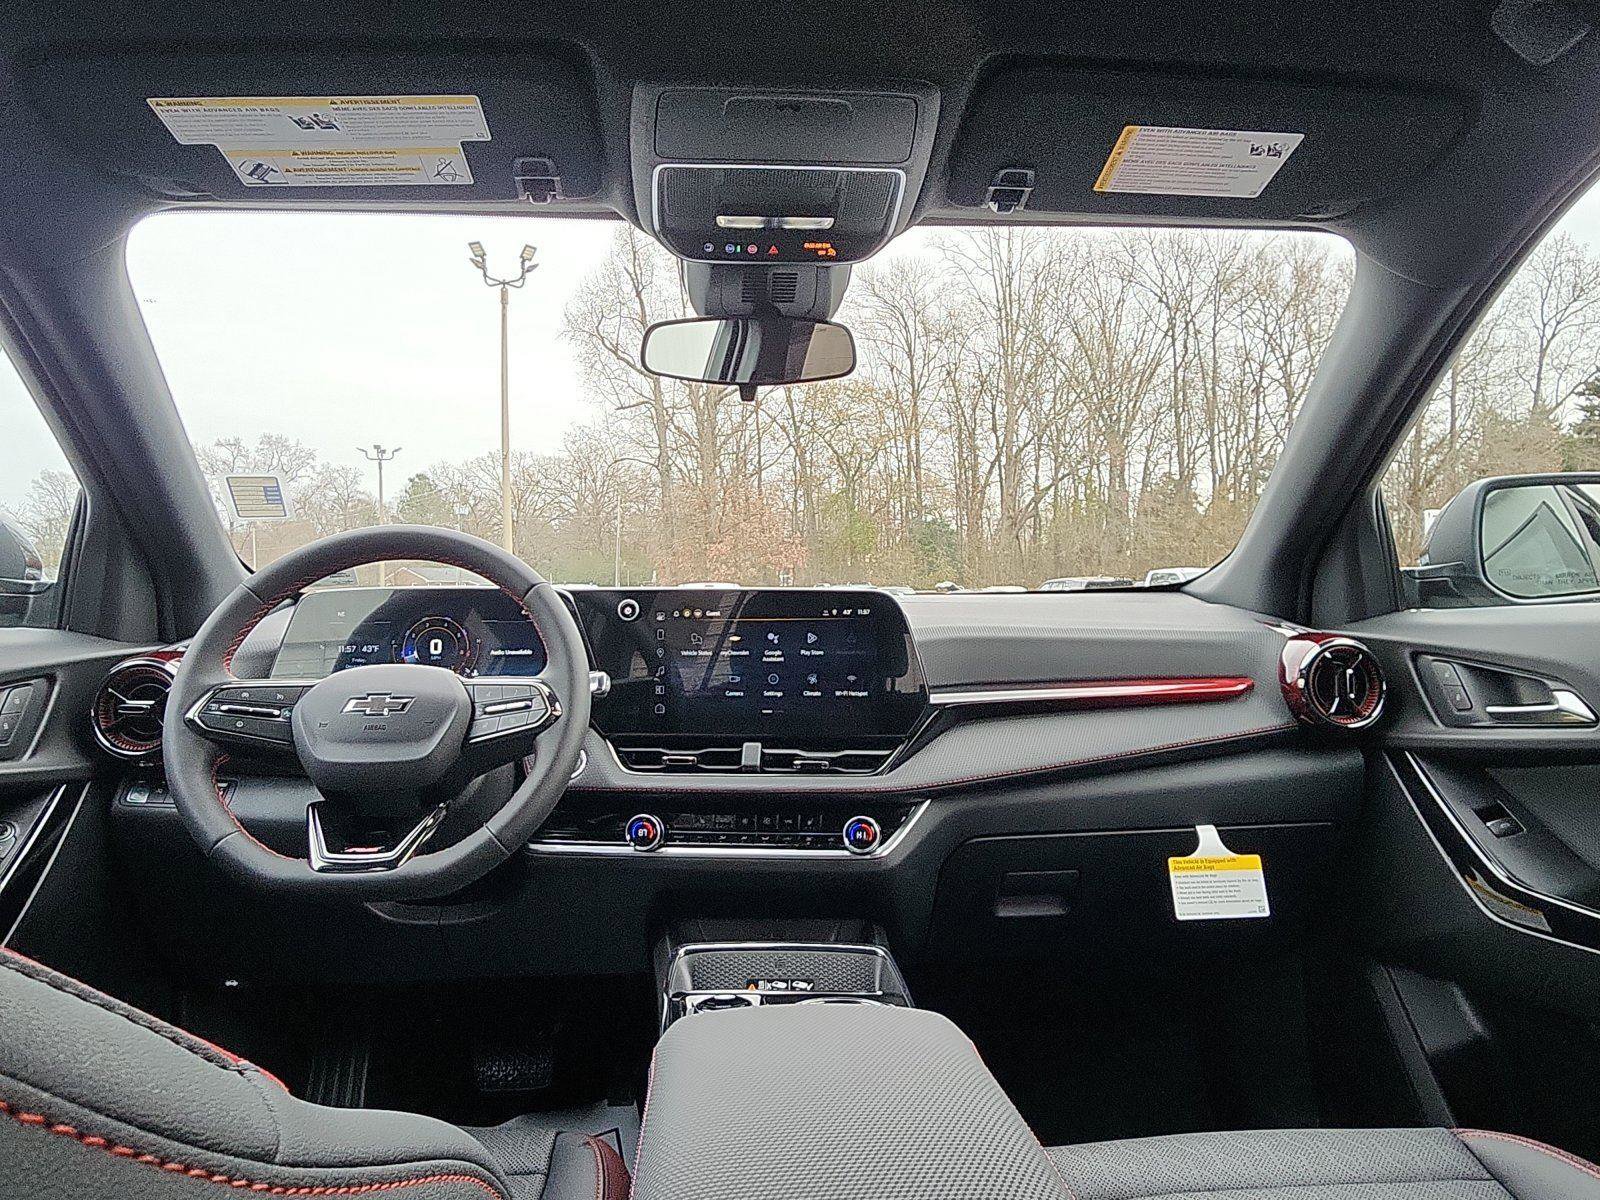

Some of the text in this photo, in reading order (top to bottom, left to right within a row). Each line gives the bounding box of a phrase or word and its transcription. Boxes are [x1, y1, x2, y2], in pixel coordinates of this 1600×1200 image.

[337, 645, 357, 653] 11:57
[429, 638, 443, 655] 0
[764, 649, 783, 657] Google
[763, 690, 783, 698] Settings
[855, 830, 867, 840] HI
